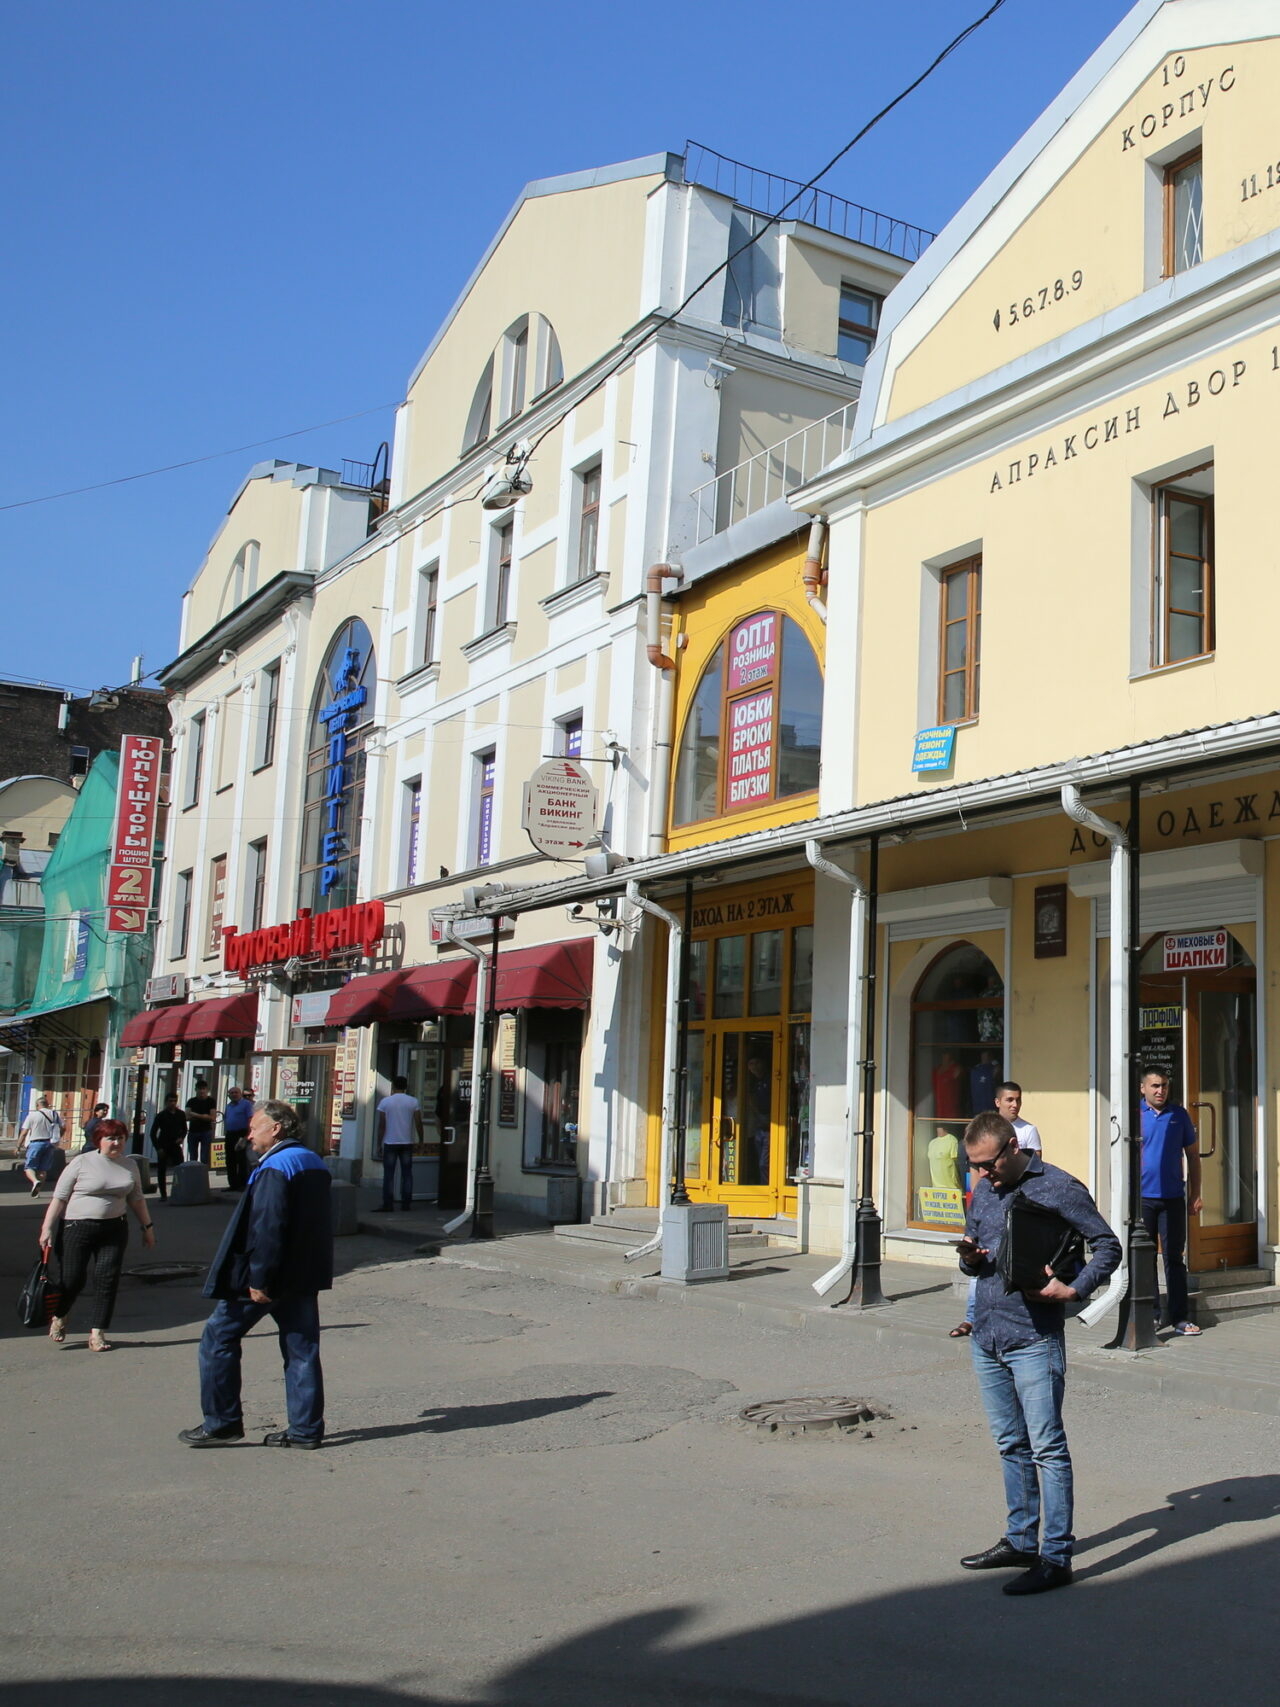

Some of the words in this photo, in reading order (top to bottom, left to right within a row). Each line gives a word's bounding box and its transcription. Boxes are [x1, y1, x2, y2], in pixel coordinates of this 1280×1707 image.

[1162, 56, 1186, 87] 10
[1121, 65, 1236, 152] КОРПУС
[989, 405, 1142, 494] АПРАКСИН
[1162, 359, 1248, 420] ДВОР
[735, 616, 774, 654] ОПТ
[732, 641, 776, 671] РОЗНИЦА
[739, 668, 747, 686] 2
[747, 663, 768, 683] этаж
[734, 694, 773, 729] ЮБКИ
[732, 720, 772, 753] БРЮКИ
[918, 728, 952, 740] СРОЧНЫЙ
[919, 739, 947, 750] РЕМОНТ
[731, 746, 772, 778] ПЛАТЬЯ
[915, 750, 947, 761] ОДЕЖДЫ
[541, 775, 565, 785] VIKING
[566, 778, 587, 786] BANK
[730, 772, 770, 803] БЛУЗКИ
[320, 732, 347, 897] ПИТЕР
[540, 807, 583, 820] ВИКИНГ
[547, 798, 577, 809] БАНК
[537, 837, 543, 845] 3
[118, 848, 150, 858] ПОШИВ
[122, 856, 147, 864] ШТОР
[117, 867, 144, 895] 2
[113, 893, 146, 903] ЭТАЖ
[693, 906, 724, 928] ВХОД
[727, 902, 744, 922] НА
[747, 899, 755, 919] 2
[756, 893, 795, 917] ЭТАЖ
[221, 907, 313, 981] Торговый
[313, 899, 385, 961] центр
[1177, 934, 1215, 949] МЕХОВЫЕ
[1166, 947, 1225, 969] ШАПКИ
[1142, 1007, 1181, 1028] ПАРФЮМ
